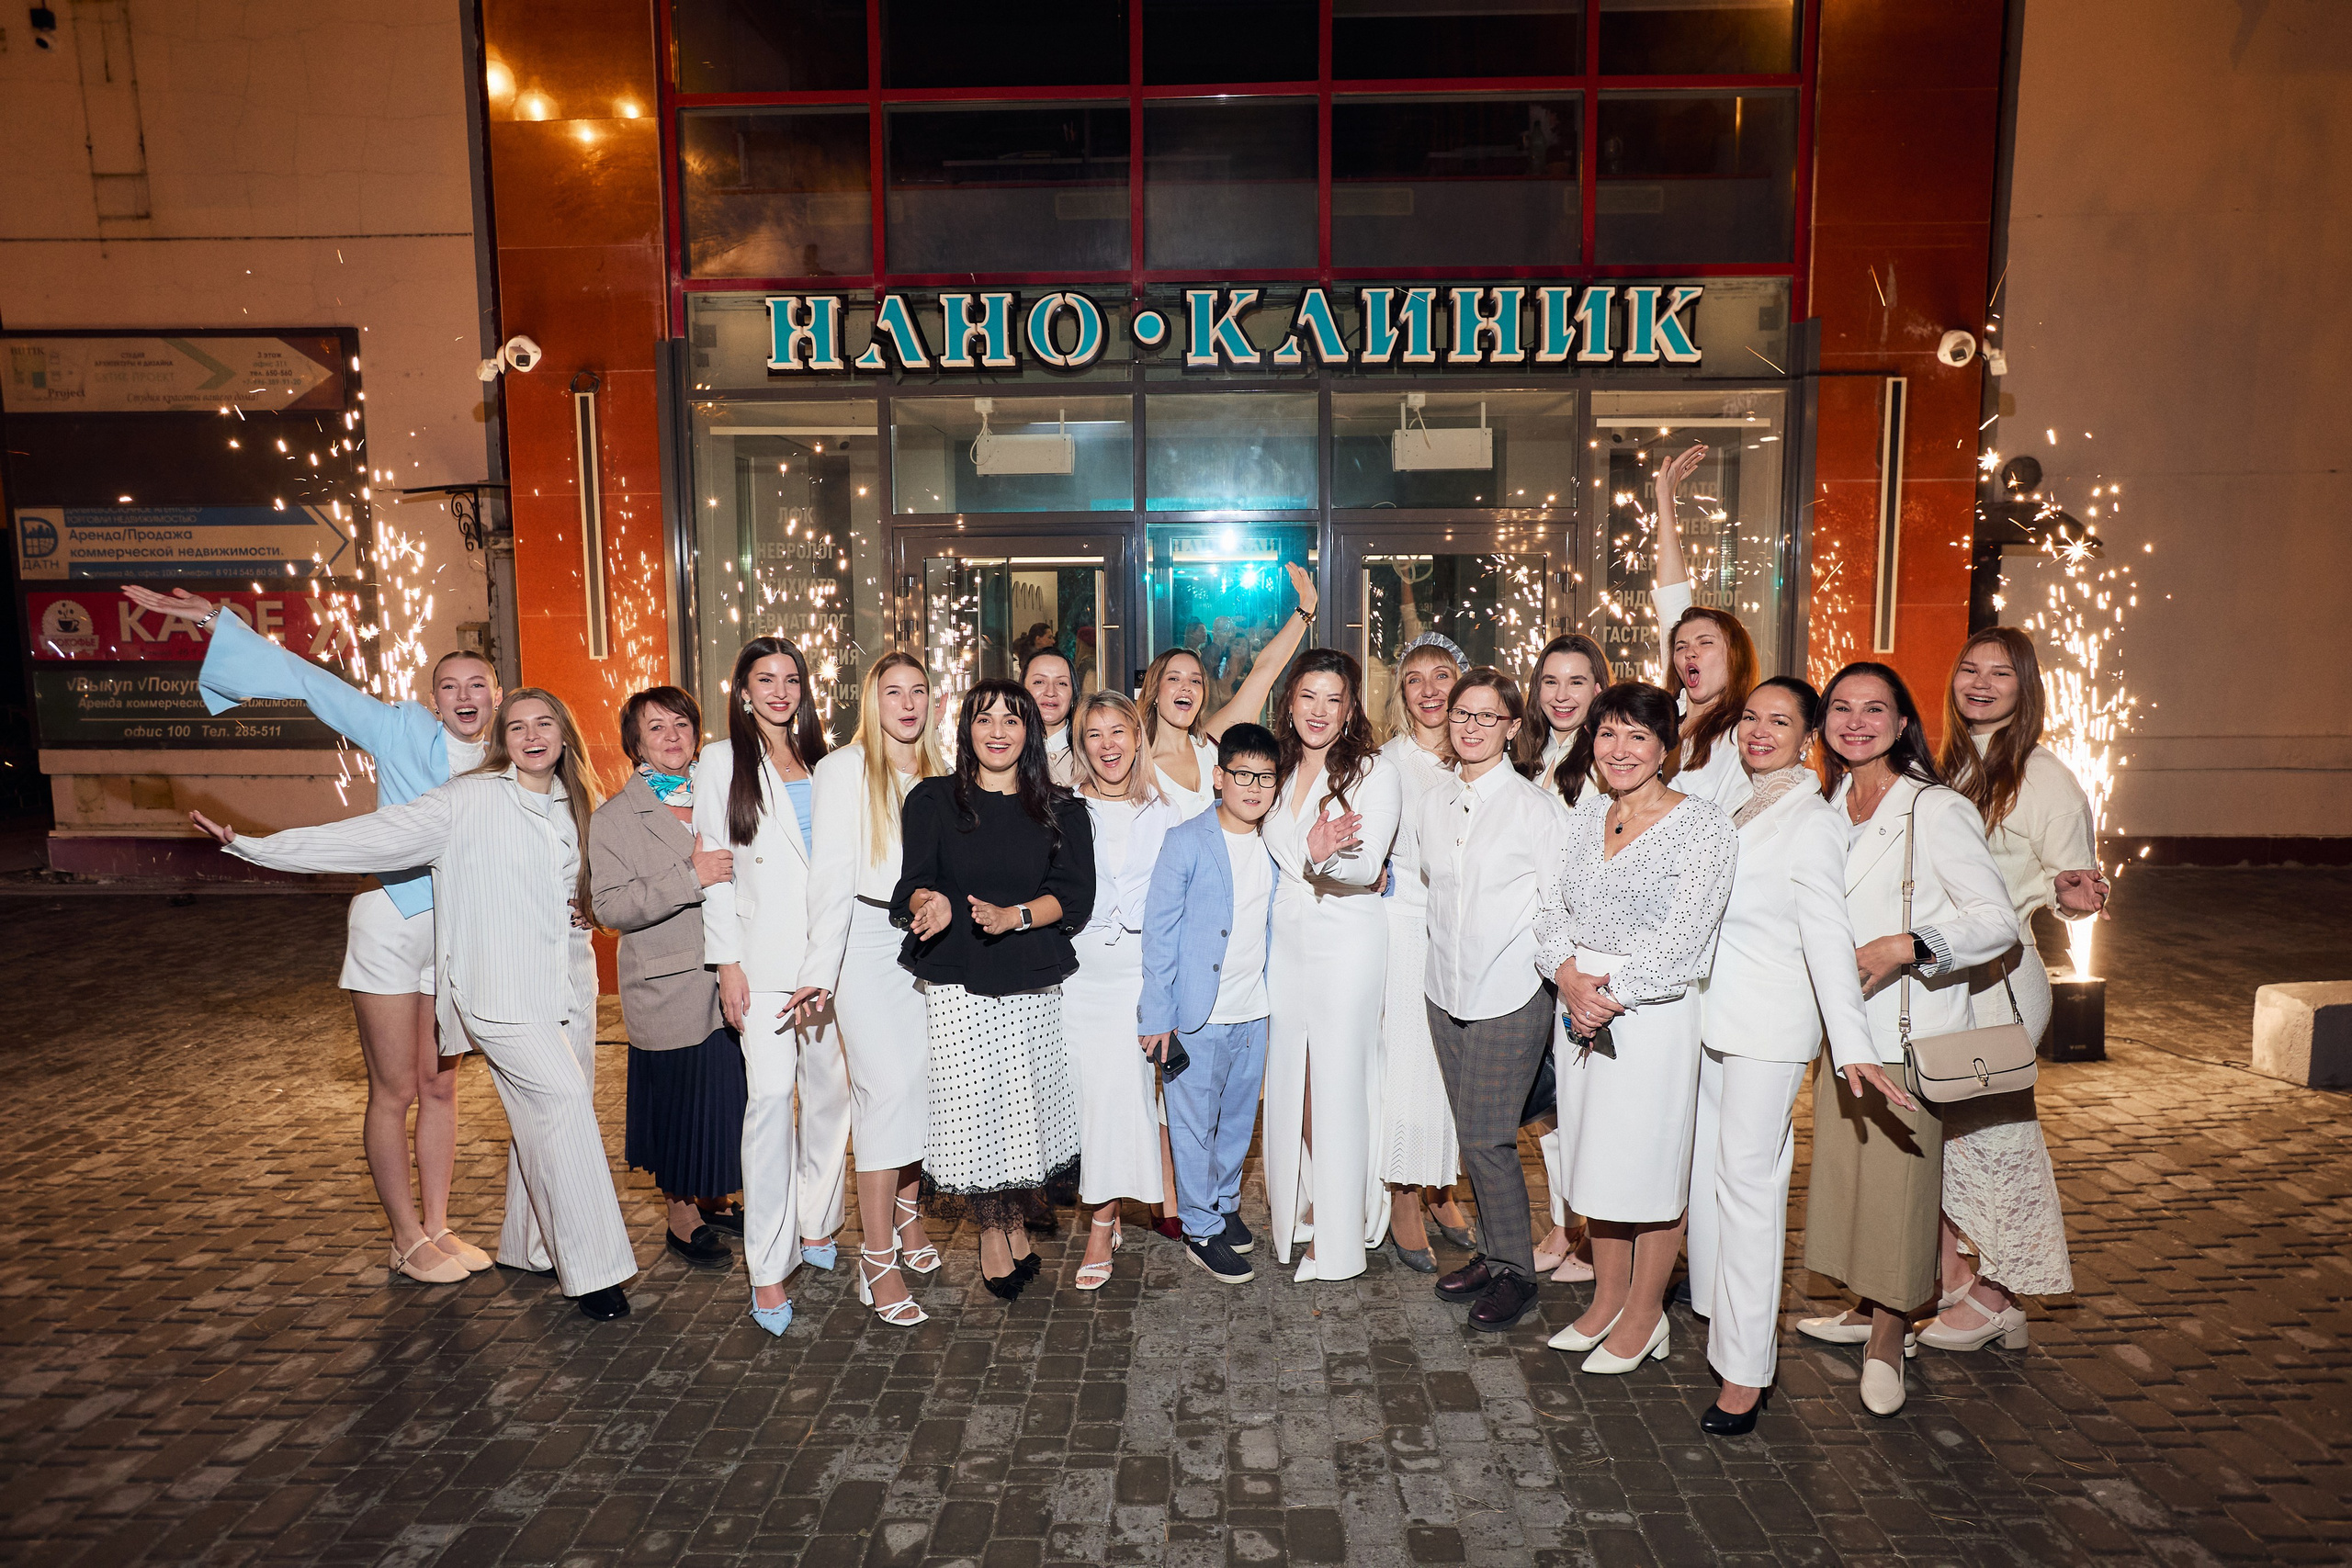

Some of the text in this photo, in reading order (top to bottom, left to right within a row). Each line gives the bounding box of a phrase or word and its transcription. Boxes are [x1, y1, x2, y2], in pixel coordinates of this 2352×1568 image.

[1185, 287, 1705, 366] КЛИНИК
[48, 388, 86, 400] Project
[1644, 480, 1718, 499] ПИАТР
[777, 506, 815, 524] ЛФК
[69, 528, 193, 544] Аренда/Продажа
[70, 546, 285, 559] коммерческой недвижимости.
[756, 542, 836, 559] НЕВРОЛОГ
[22, 559, 60, 571] ДАТН
[216, 569, 221, 577] 8
[222, 569, 237, 577] 914
[240, 568, 254, 577] 545
[747, 613, 848, 630] РЕВМАТОЛОГ
[78, 698, 122, 710] Аренда
[126, 698, 205, 711] коммерческо
[123, 725, 282, 739] офис 100 Тел. 285-511
